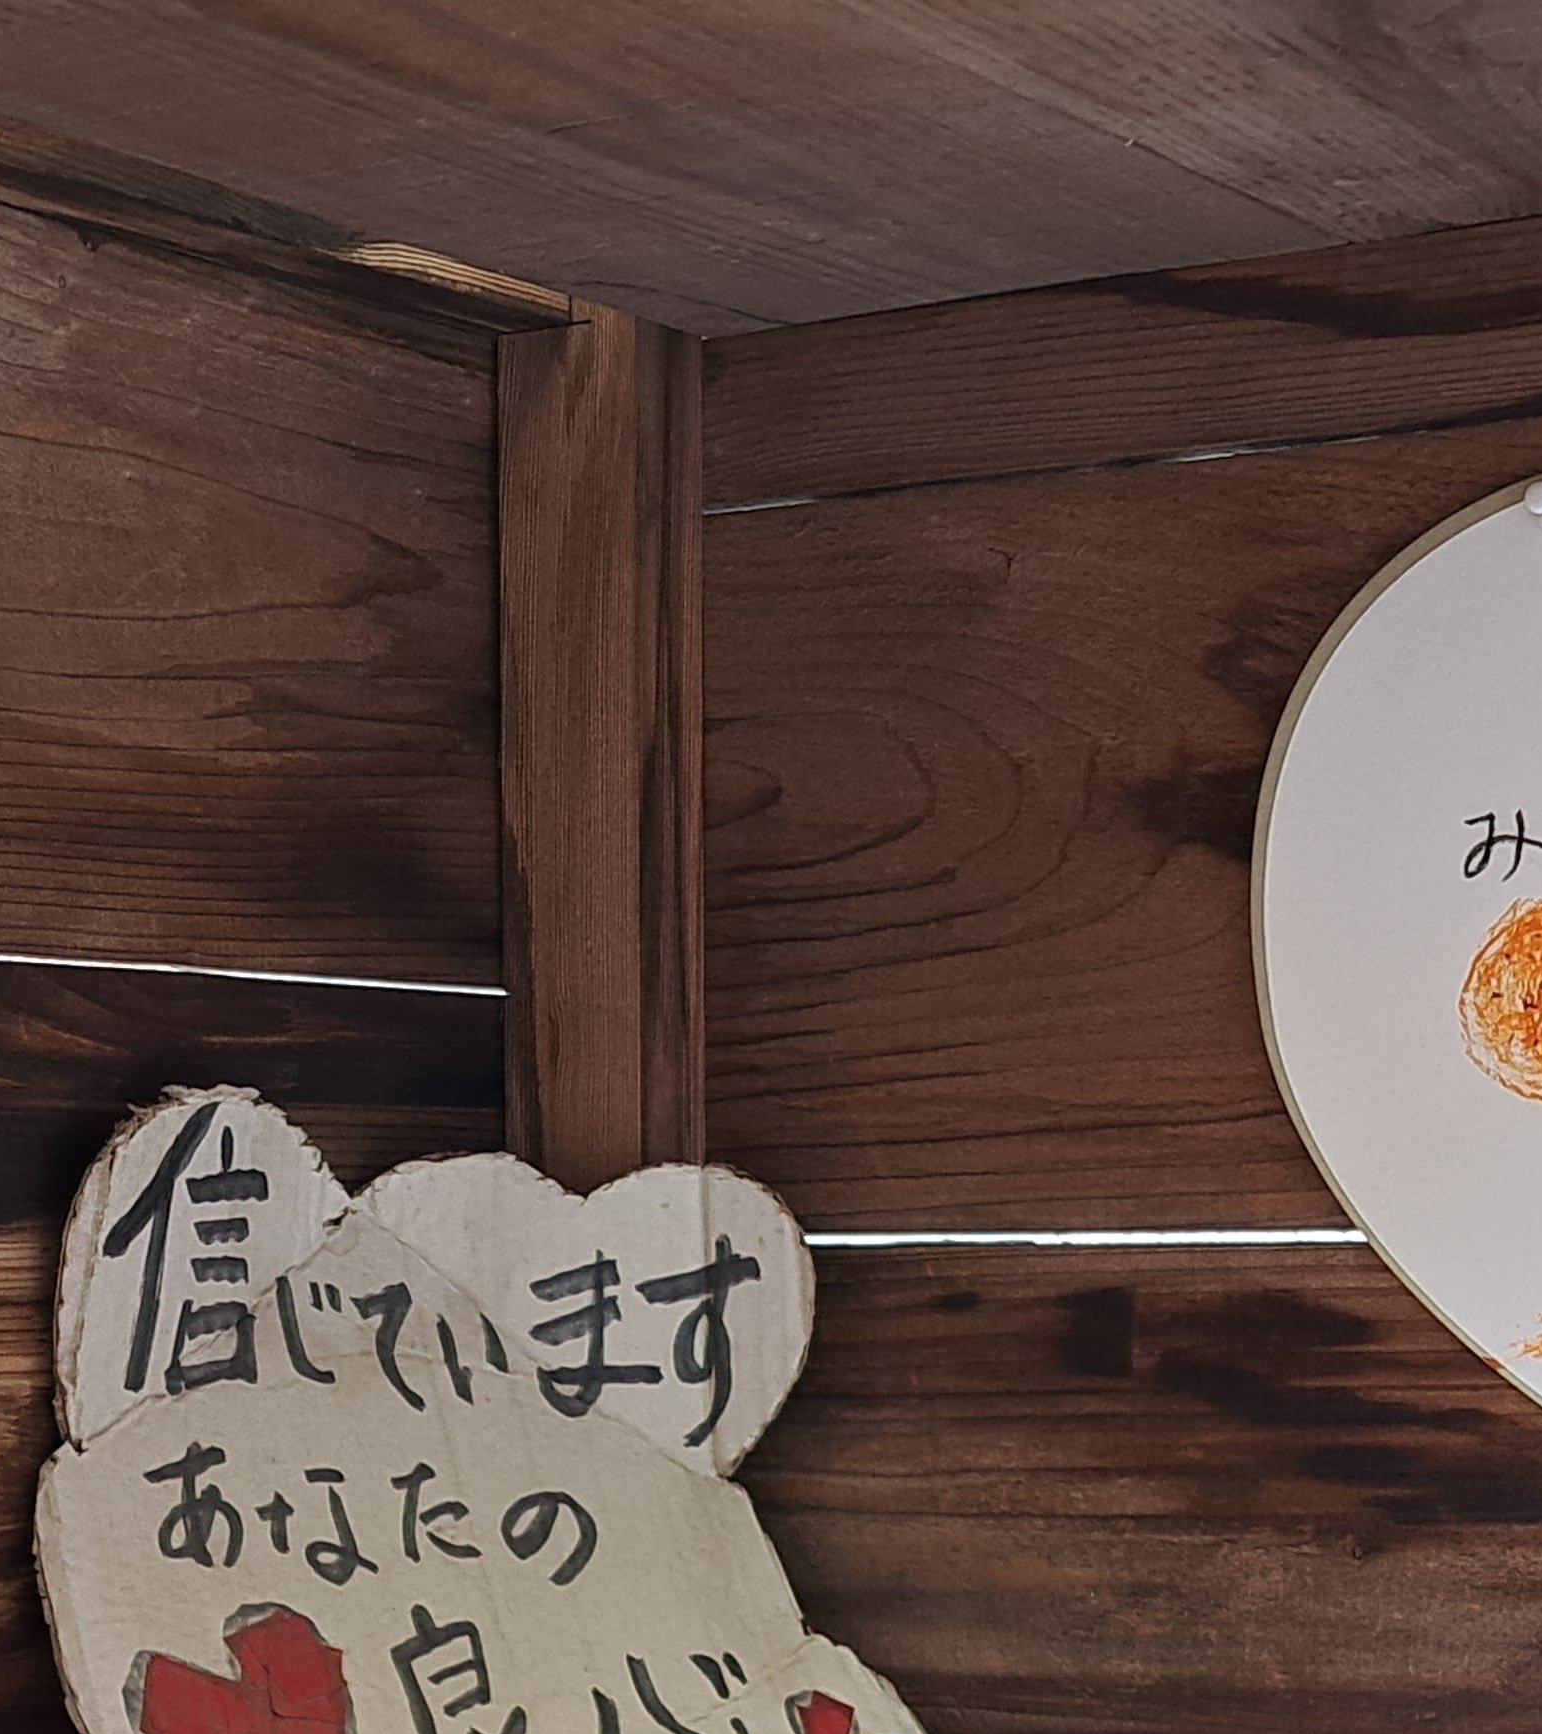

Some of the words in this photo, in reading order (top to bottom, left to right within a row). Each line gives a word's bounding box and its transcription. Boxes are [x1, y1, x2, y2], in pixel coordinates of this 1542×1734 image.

[101, 1100, 763, 1448] 信じています
[143, 1440, 599, 1586] あなたの
